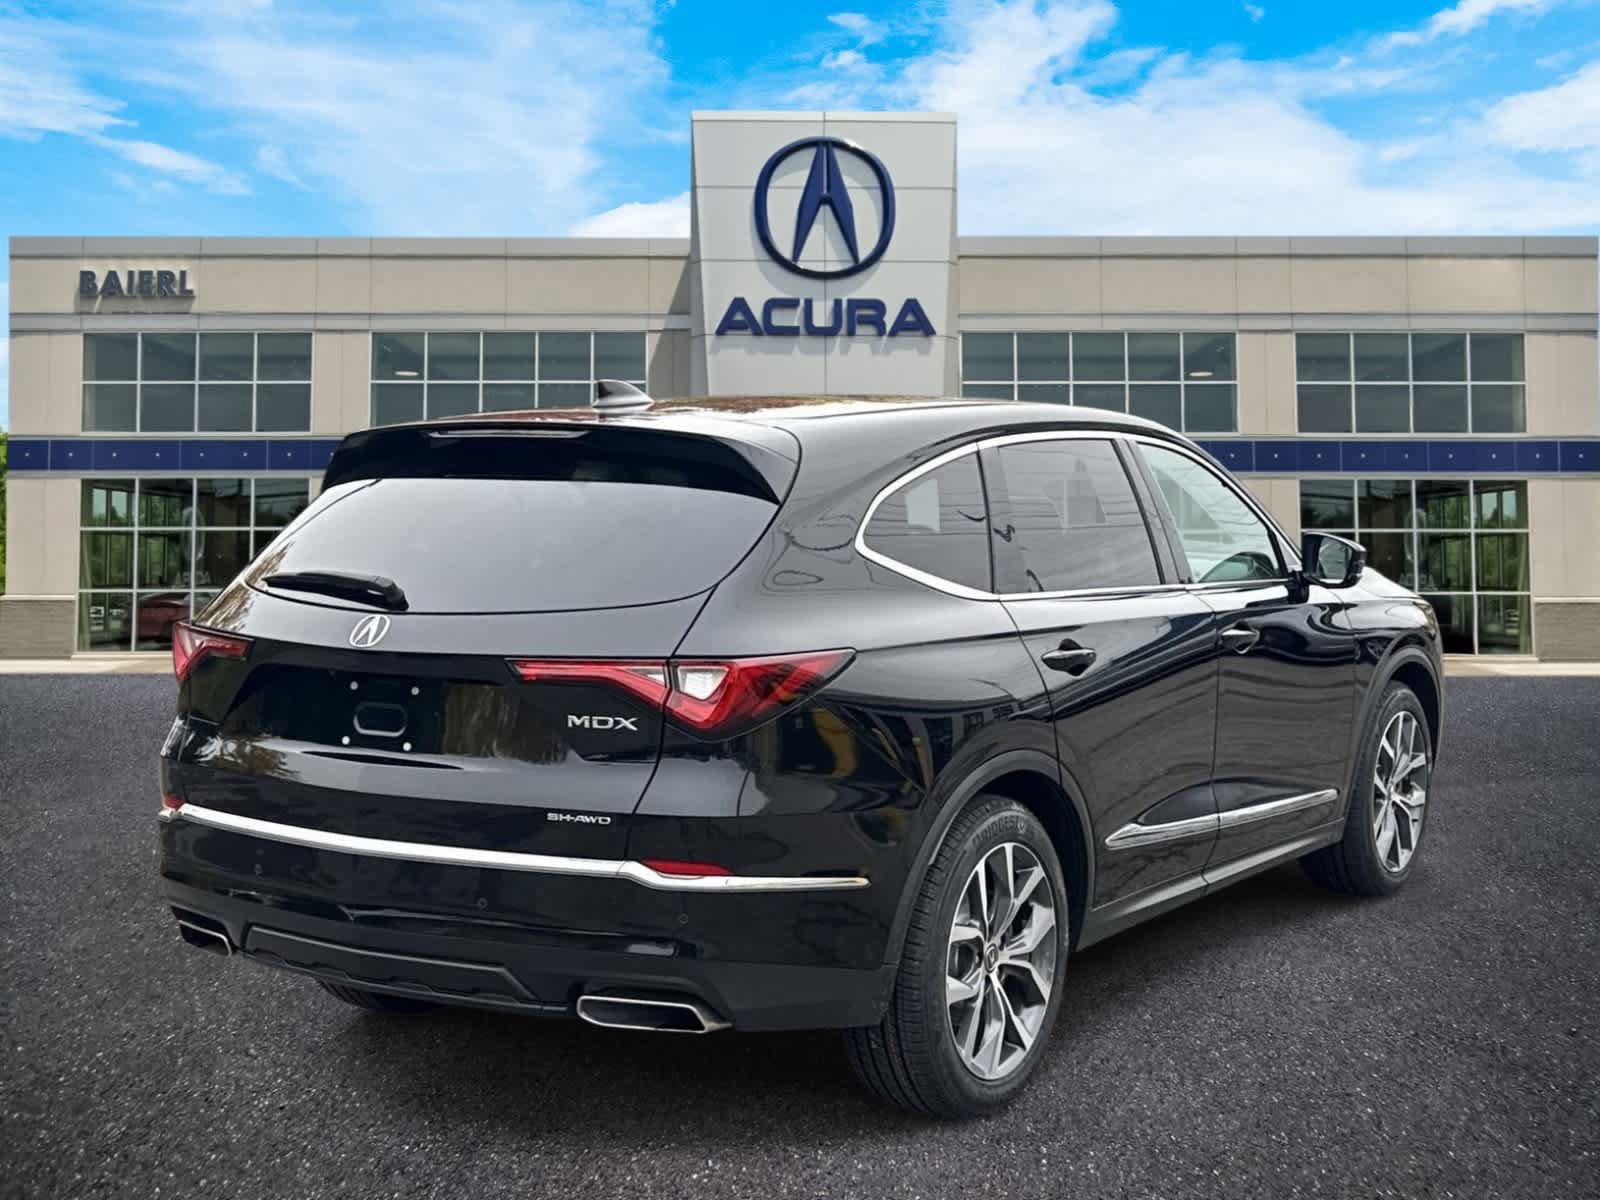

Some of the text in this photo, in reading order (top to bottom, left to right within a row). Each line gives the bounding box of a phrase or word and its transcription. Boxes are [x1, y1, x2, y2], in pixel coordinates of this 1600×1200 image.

[79, 269, 195, 297] BAIERL
[714, 296, 937, 337] ACURA
[567, 714, 638, 731] MDX
[547, 812, 611, 825] SH-AWD
